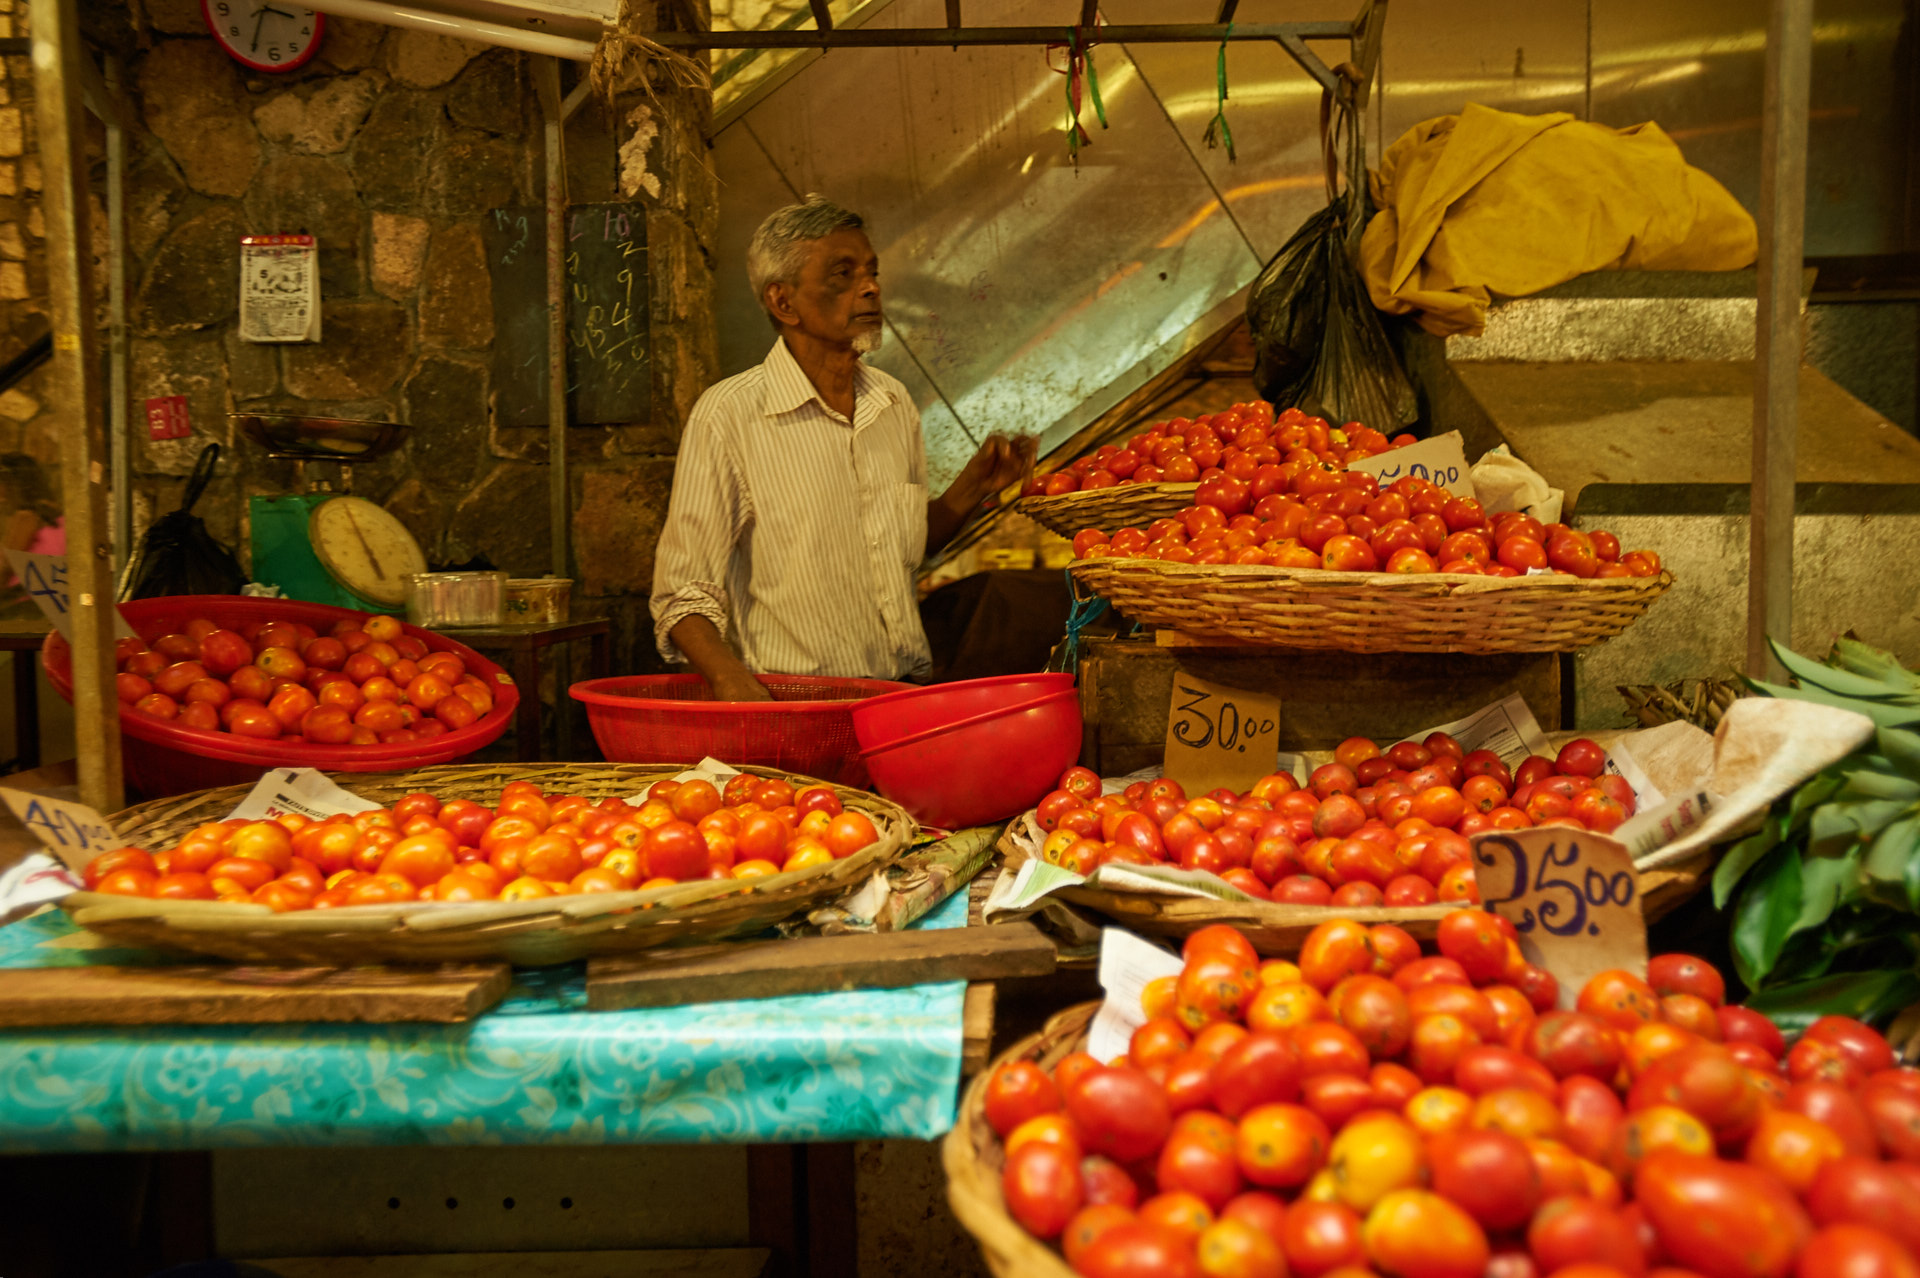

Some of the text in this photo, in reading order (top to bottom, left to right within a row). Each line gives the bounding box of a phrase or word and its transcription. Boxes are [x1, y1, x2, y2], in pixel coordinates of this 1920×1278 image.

[217, 3, 229, 16] 9
[229, 26, 239, 37] 8
[301, 26, 310, 36] 4
[288, 42, 298, 52] 5
[268, 47, 281, 61] 6
[1173, 685, 1275, 753] 30.00
[1476, 834, 1634, 937] 25.00
